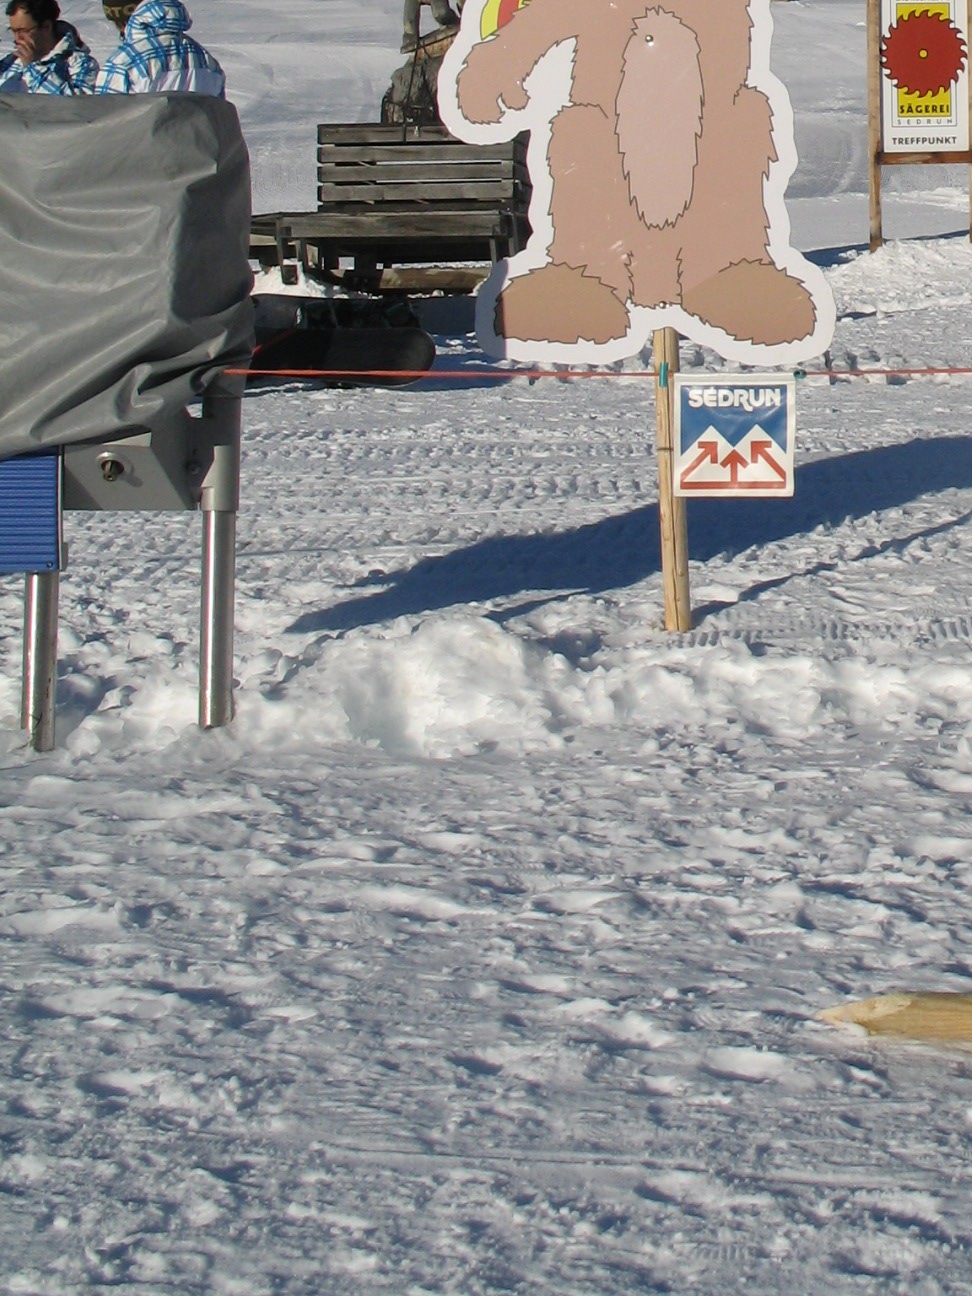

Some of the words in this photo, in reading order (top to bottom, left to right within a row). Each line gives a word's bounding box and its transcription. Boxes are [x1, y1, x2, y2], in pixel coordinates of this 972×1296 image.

[899, 102, 950, 114] SÄGEREI
[892, 136, 957, 145] TREFFPUNKT
[688, 388, 781, 412] SEDRUN
